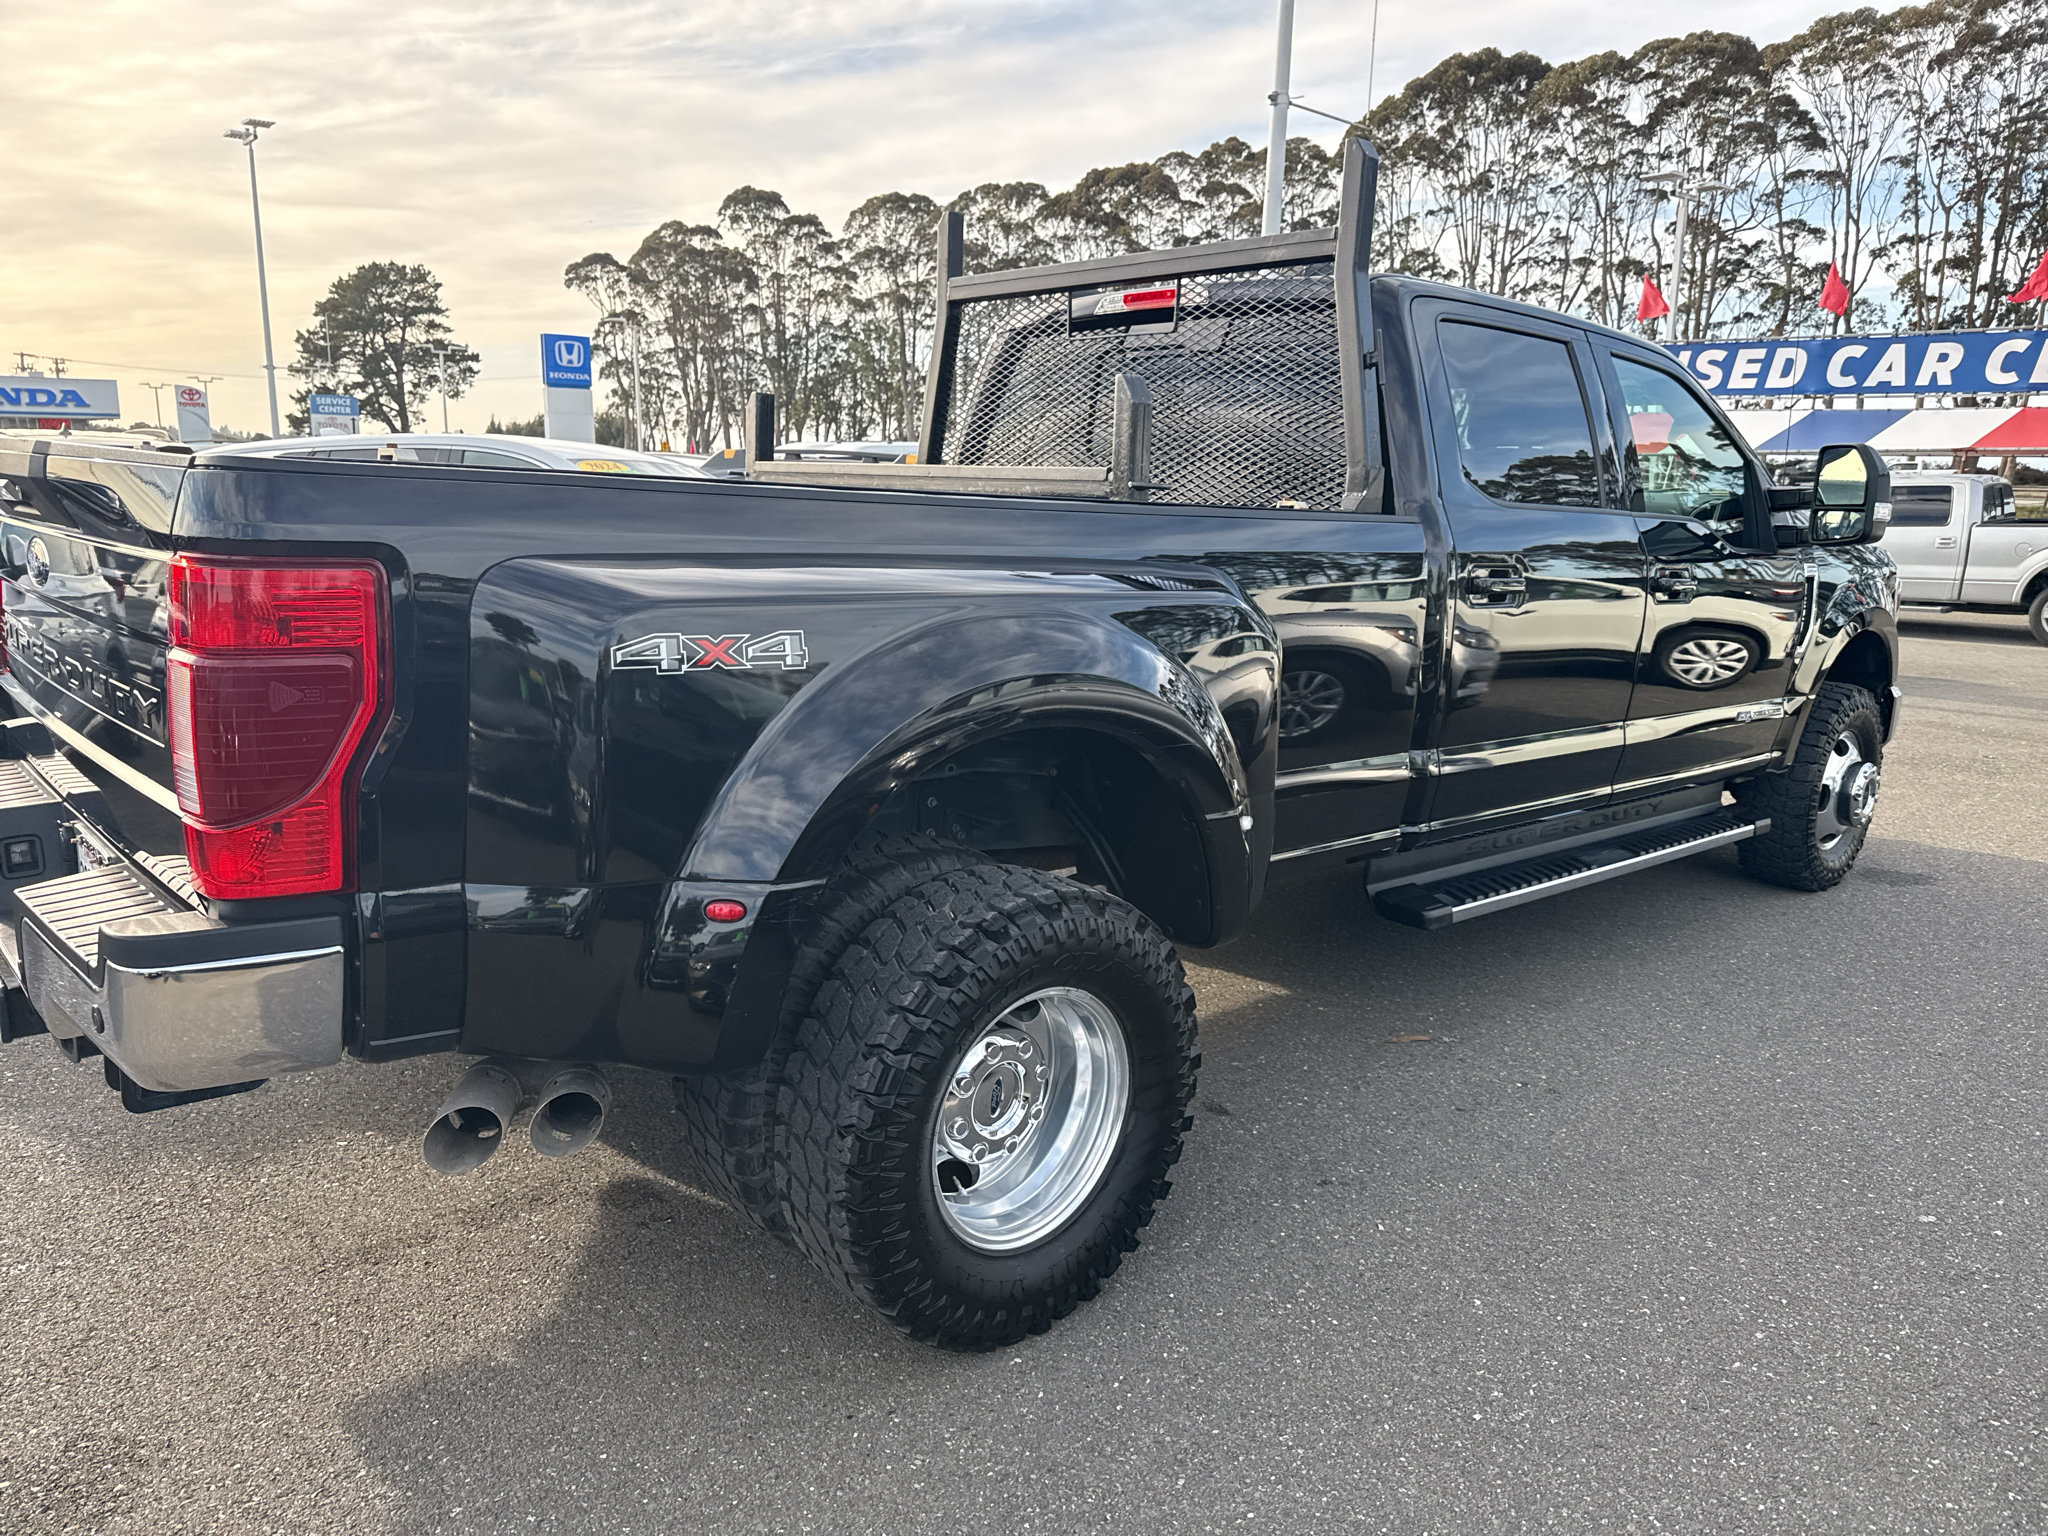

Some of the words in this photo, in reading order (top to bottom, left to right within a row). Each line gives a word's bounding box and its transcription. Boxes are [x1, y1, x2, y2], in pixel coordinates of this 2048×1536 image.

[1826, 342, 1964, 389] CAR
[549, 371, 590, 381] HONDA
[315, 397, 351, 406] SERVICE
[318, 405, 352, 414] CENTER
[317, 421, 349, 430] TOYOTA
[64, 655, 158, 729] DUTY
[1589, 799, 1664, 827] DUTY
